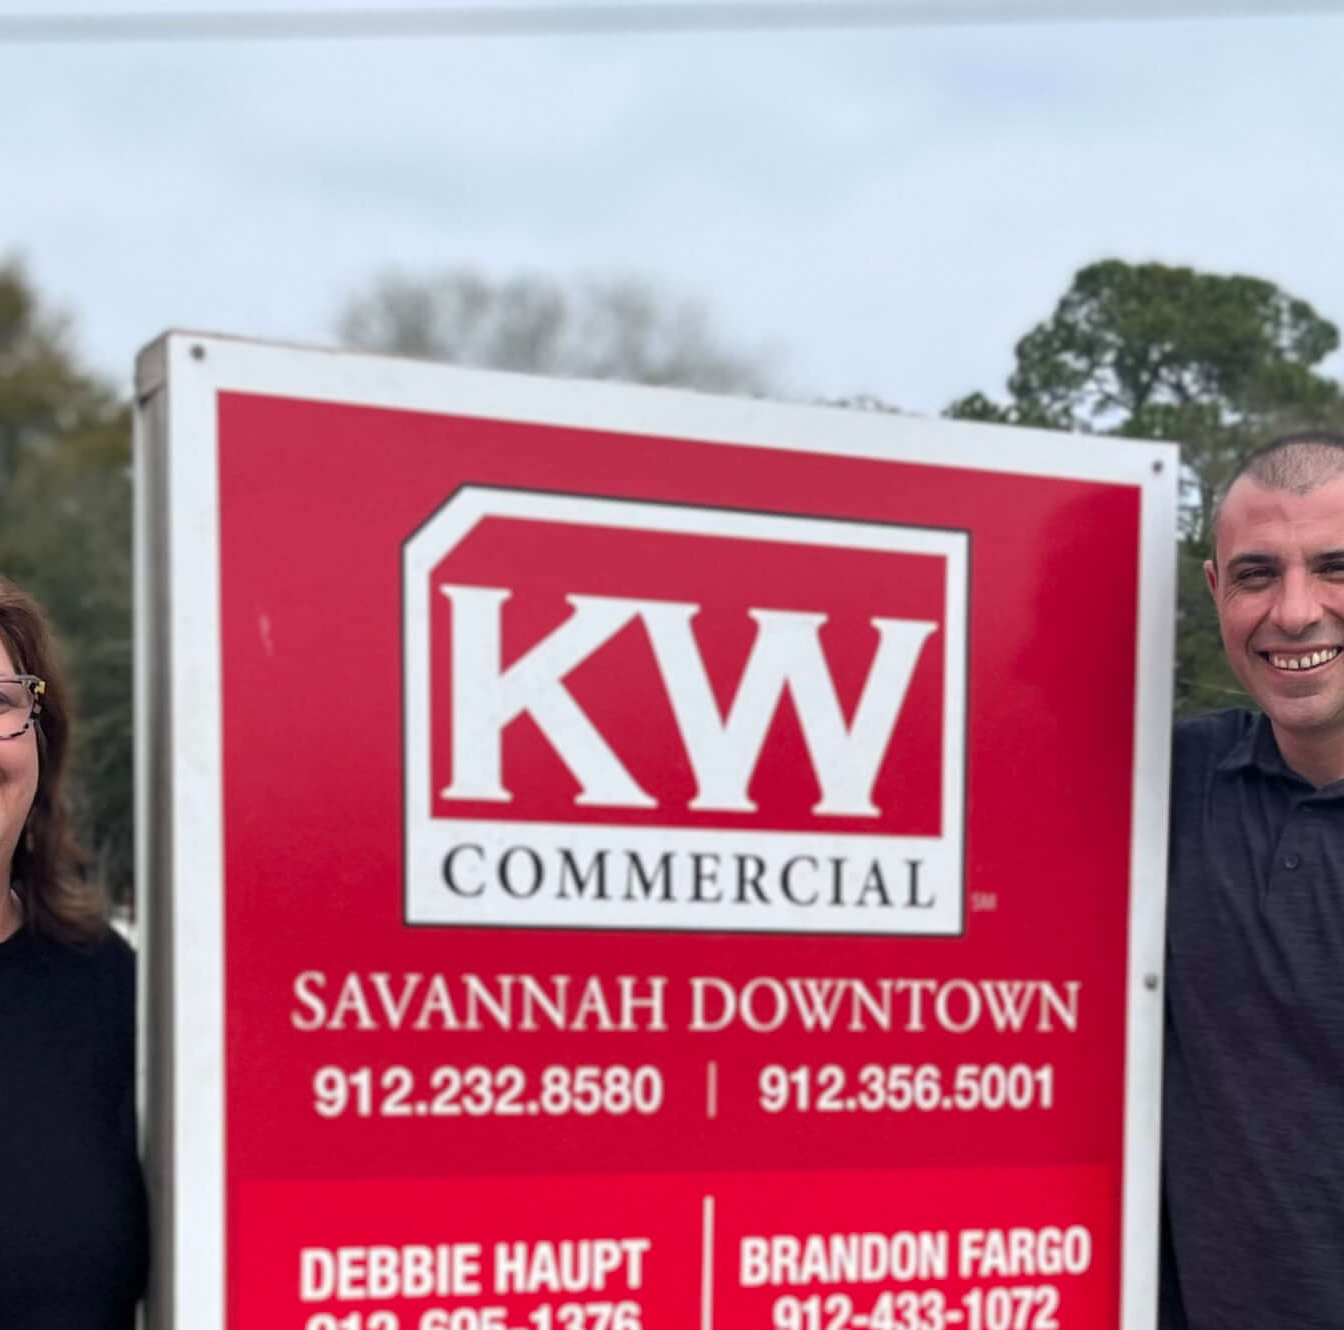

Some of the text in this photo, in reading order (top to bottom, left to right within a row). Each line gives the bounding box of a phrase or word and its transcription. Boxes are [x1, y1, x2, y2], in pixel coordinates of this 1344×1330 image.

[439, 583, 938, 818] KW
[440, 844, 935, 910] COMMERCIAL
[290, 969, 1082, 1034] SAVANNAH DOWNTOWN
[312, 1063, 664, 1118] 912.232.8580
[758, 1062, 1055, 1113] 912.356.5001
[299, 1237, 652, 1302] DEBBIE HAUPT
[739, 1224, 1093, 1287] BRANDON FARGO
